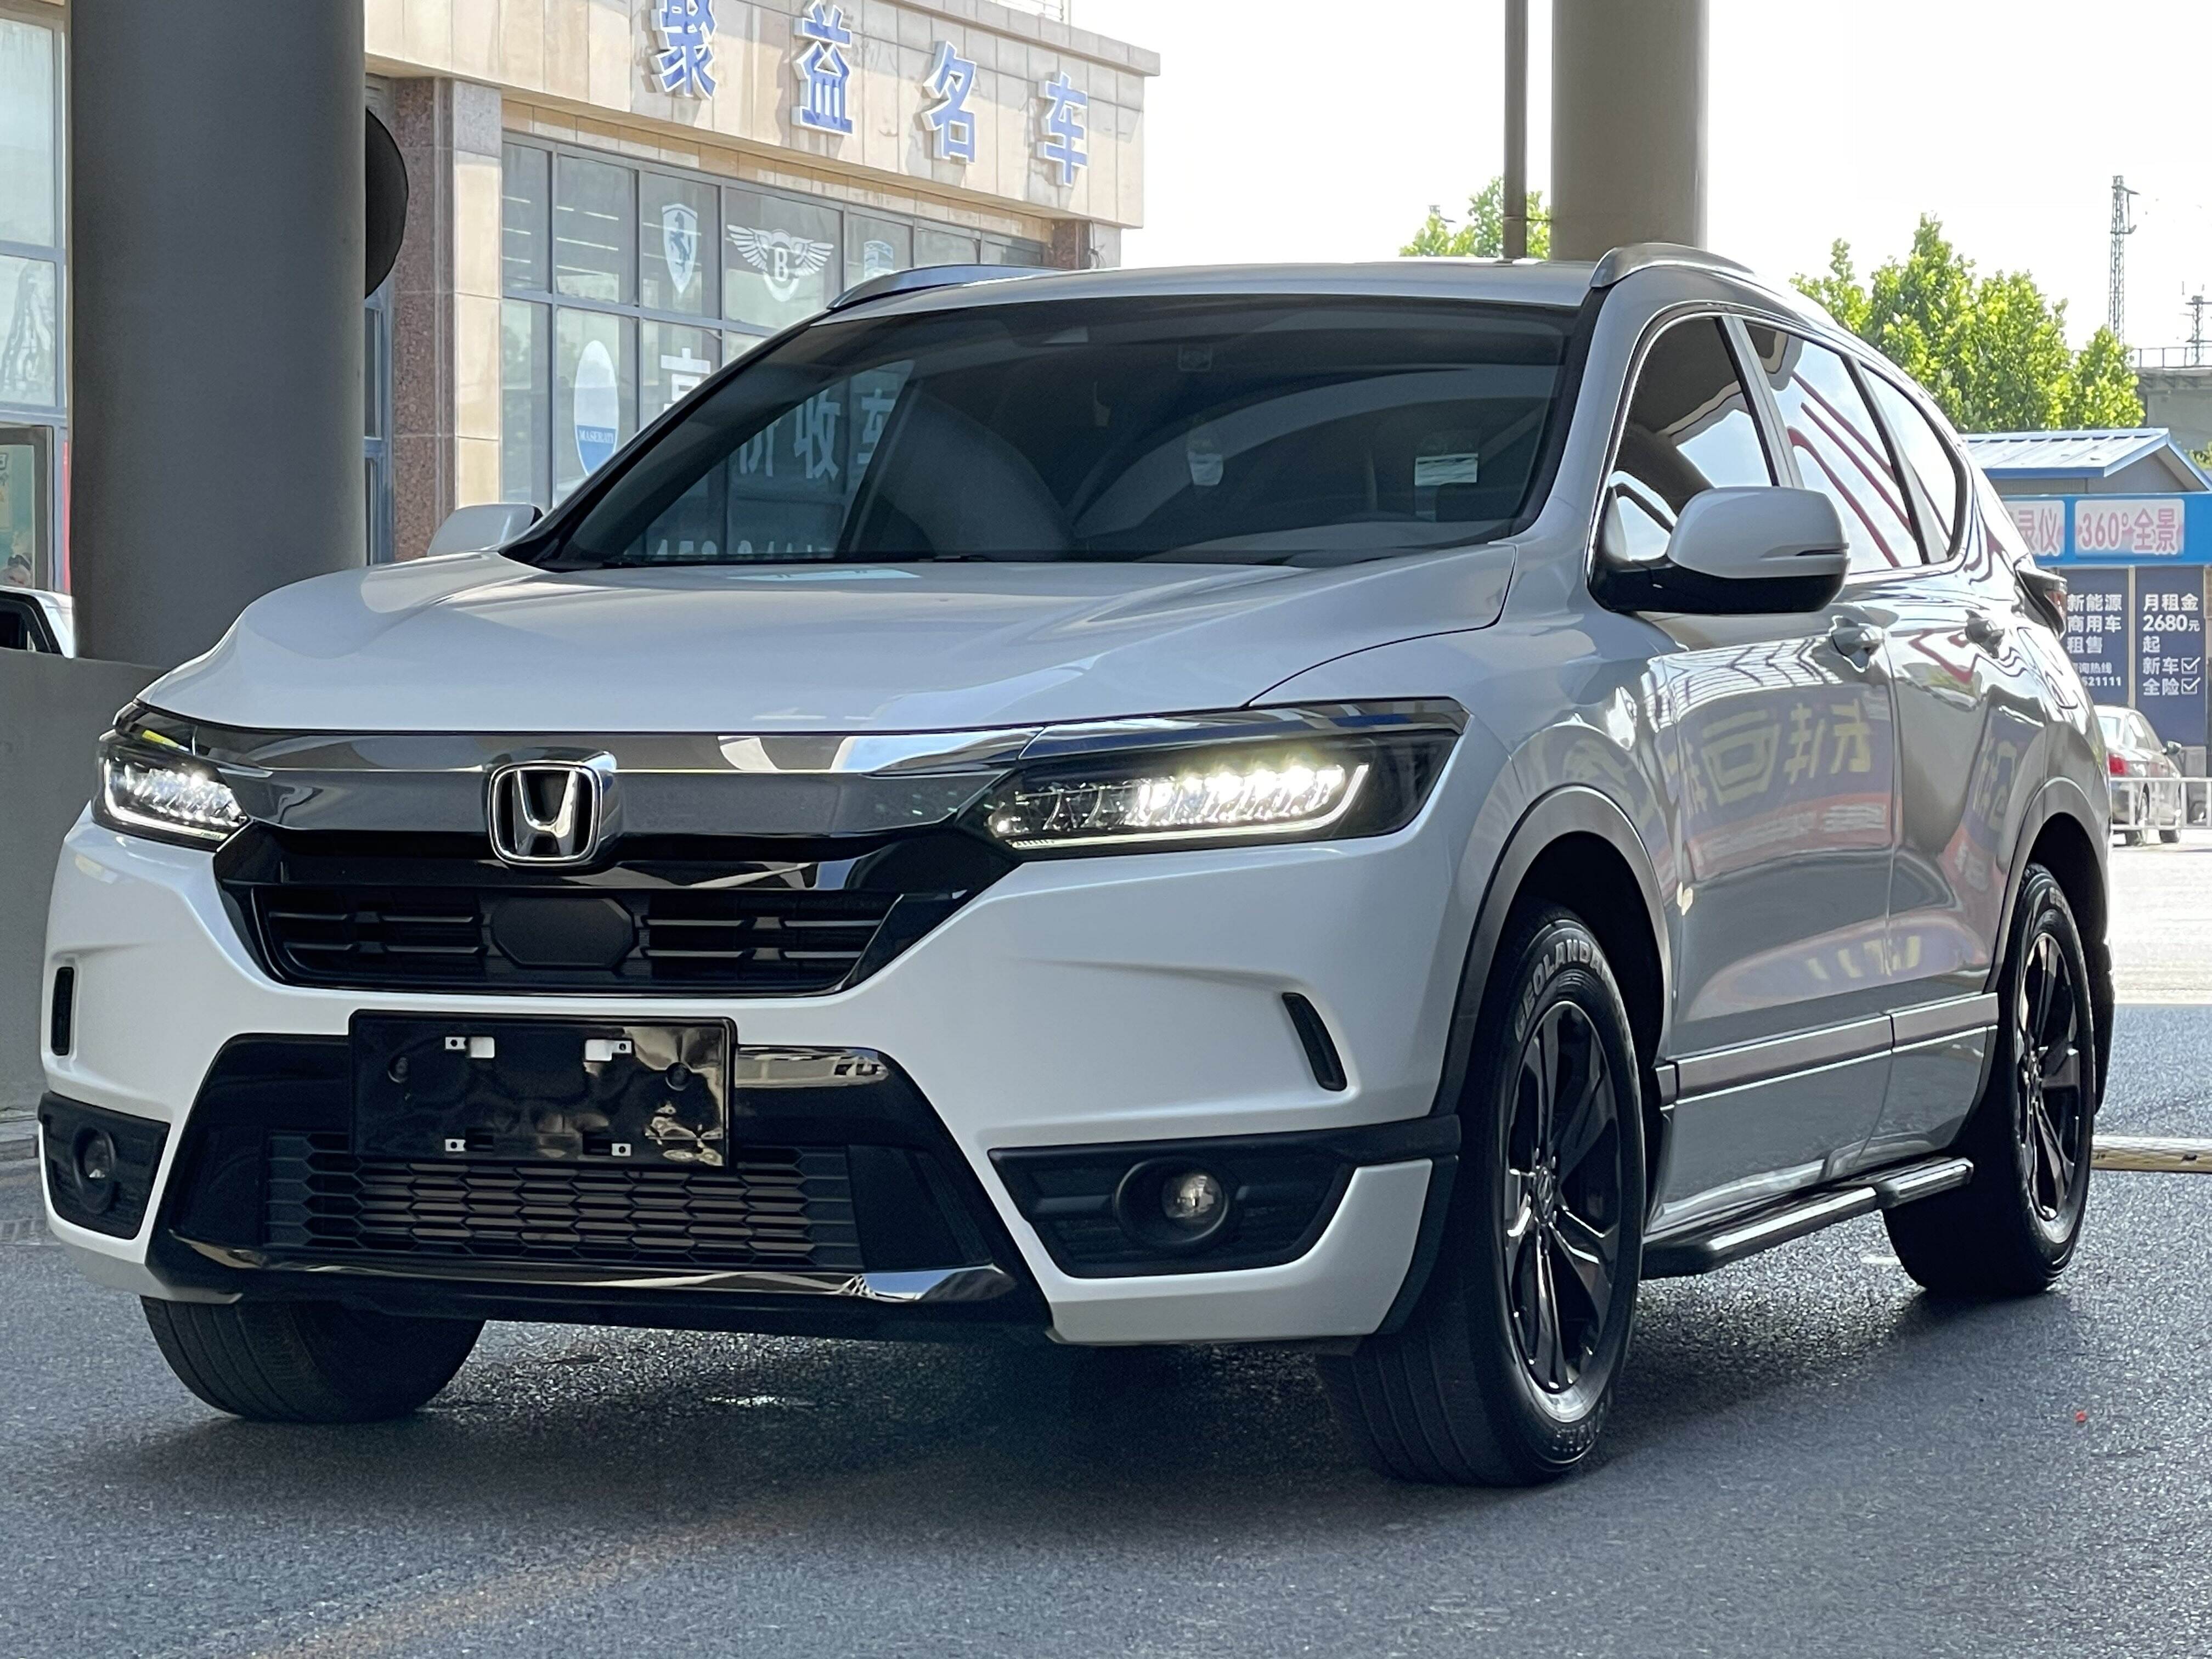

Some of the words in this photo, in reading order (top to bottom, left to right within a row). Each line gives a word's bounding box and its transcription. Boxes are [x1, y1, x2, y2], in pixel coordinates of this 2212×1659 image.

[2008, 508, 2058, 553] 录仪
[2067, 594, 2122, 612] 新能源
[2143, 593, 2199, 612] 月租金
[2067, 615, 2122, 633] 商用车
[2067, 636, 2102, 654] 租售
[2142, 635, 2160, 653] 起
[2143, 657, 2179, 675] 新车
[2143, 678, 2179, 696] 全险
